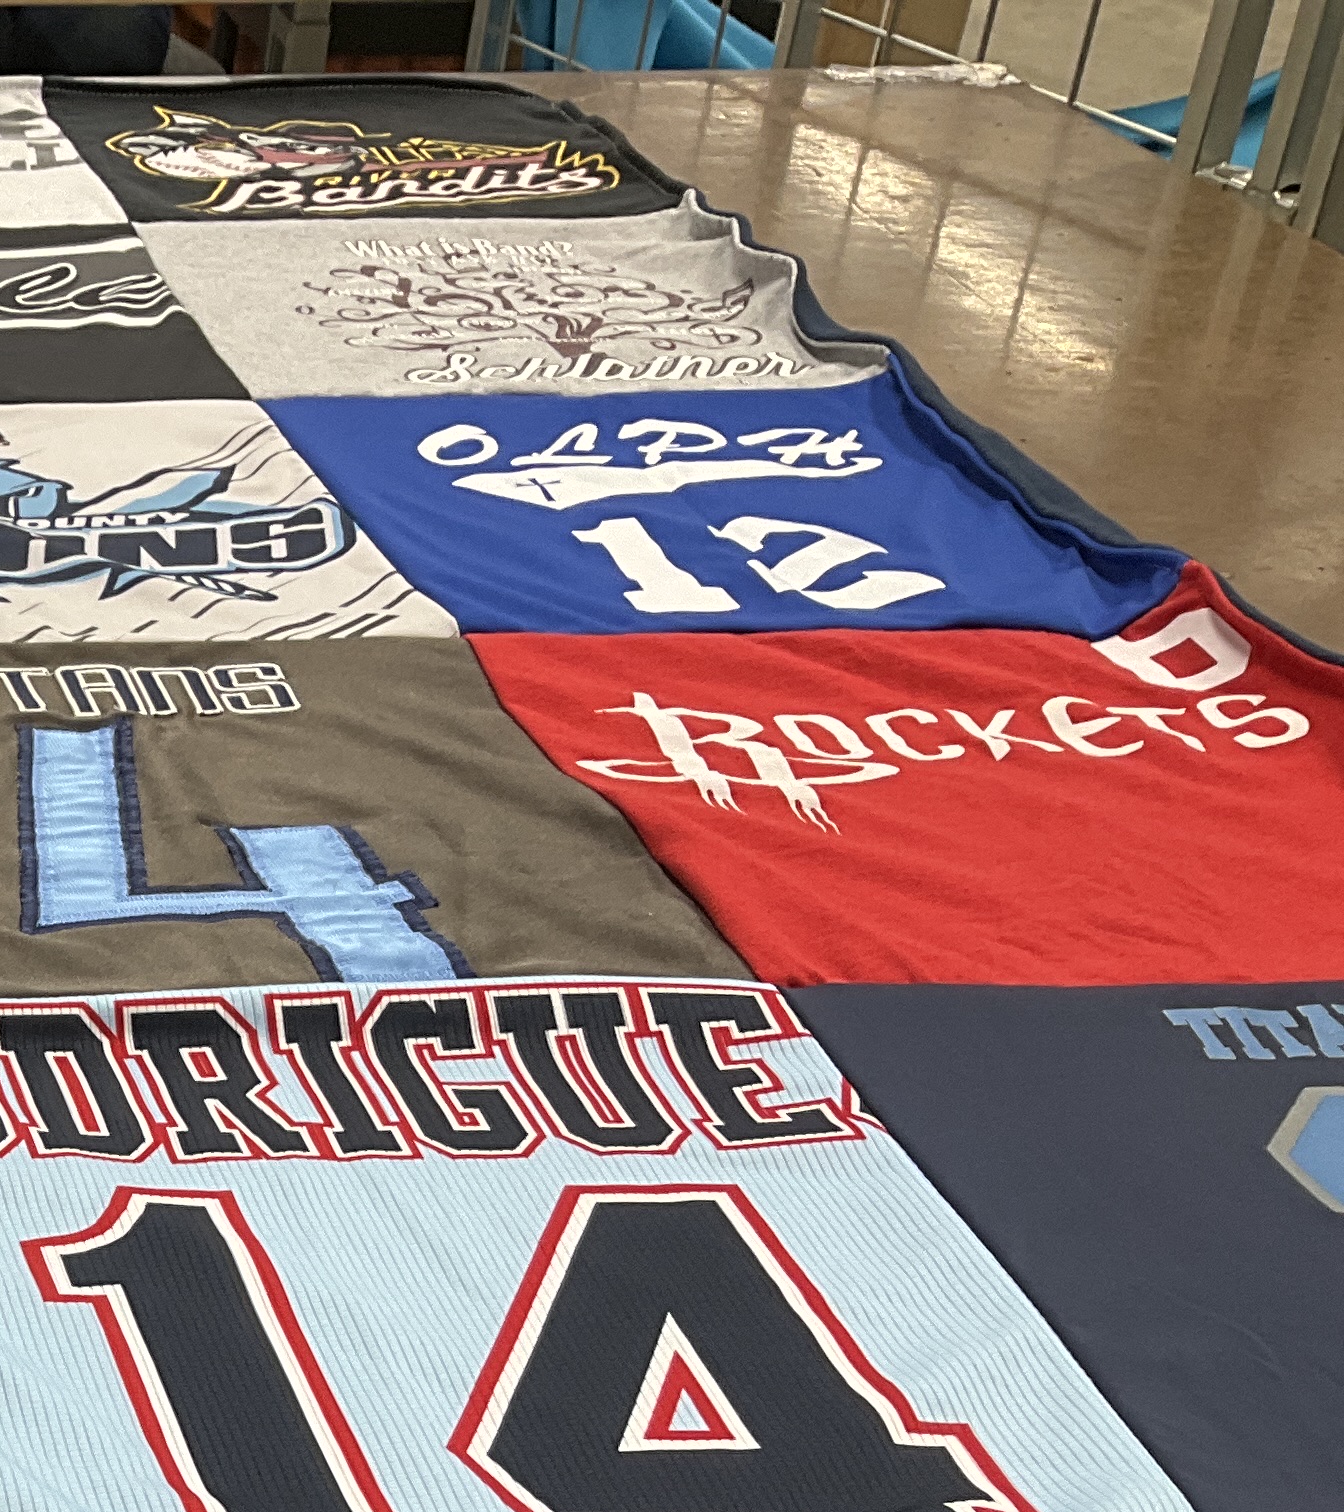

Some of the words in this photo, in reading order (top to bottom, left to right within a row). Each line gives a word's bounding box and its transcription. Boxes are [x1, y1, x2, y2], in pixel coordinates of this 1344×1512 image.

[215, 162, 606, 213] Bandits
[343, 240, 437, 258] What
[438, 236, 470, 254] is
[471, 238, 574, 259] Band?
[406, 351, 814, 384] Schlather
[16, 511, 190, 531] OUNTY
[572, 515, 947, 614] 12
[576, 691, 1311, 834] ROCKETS
[15, 715, 477, 984] 4
[1161, 1002, 1344, 1061] TITA
